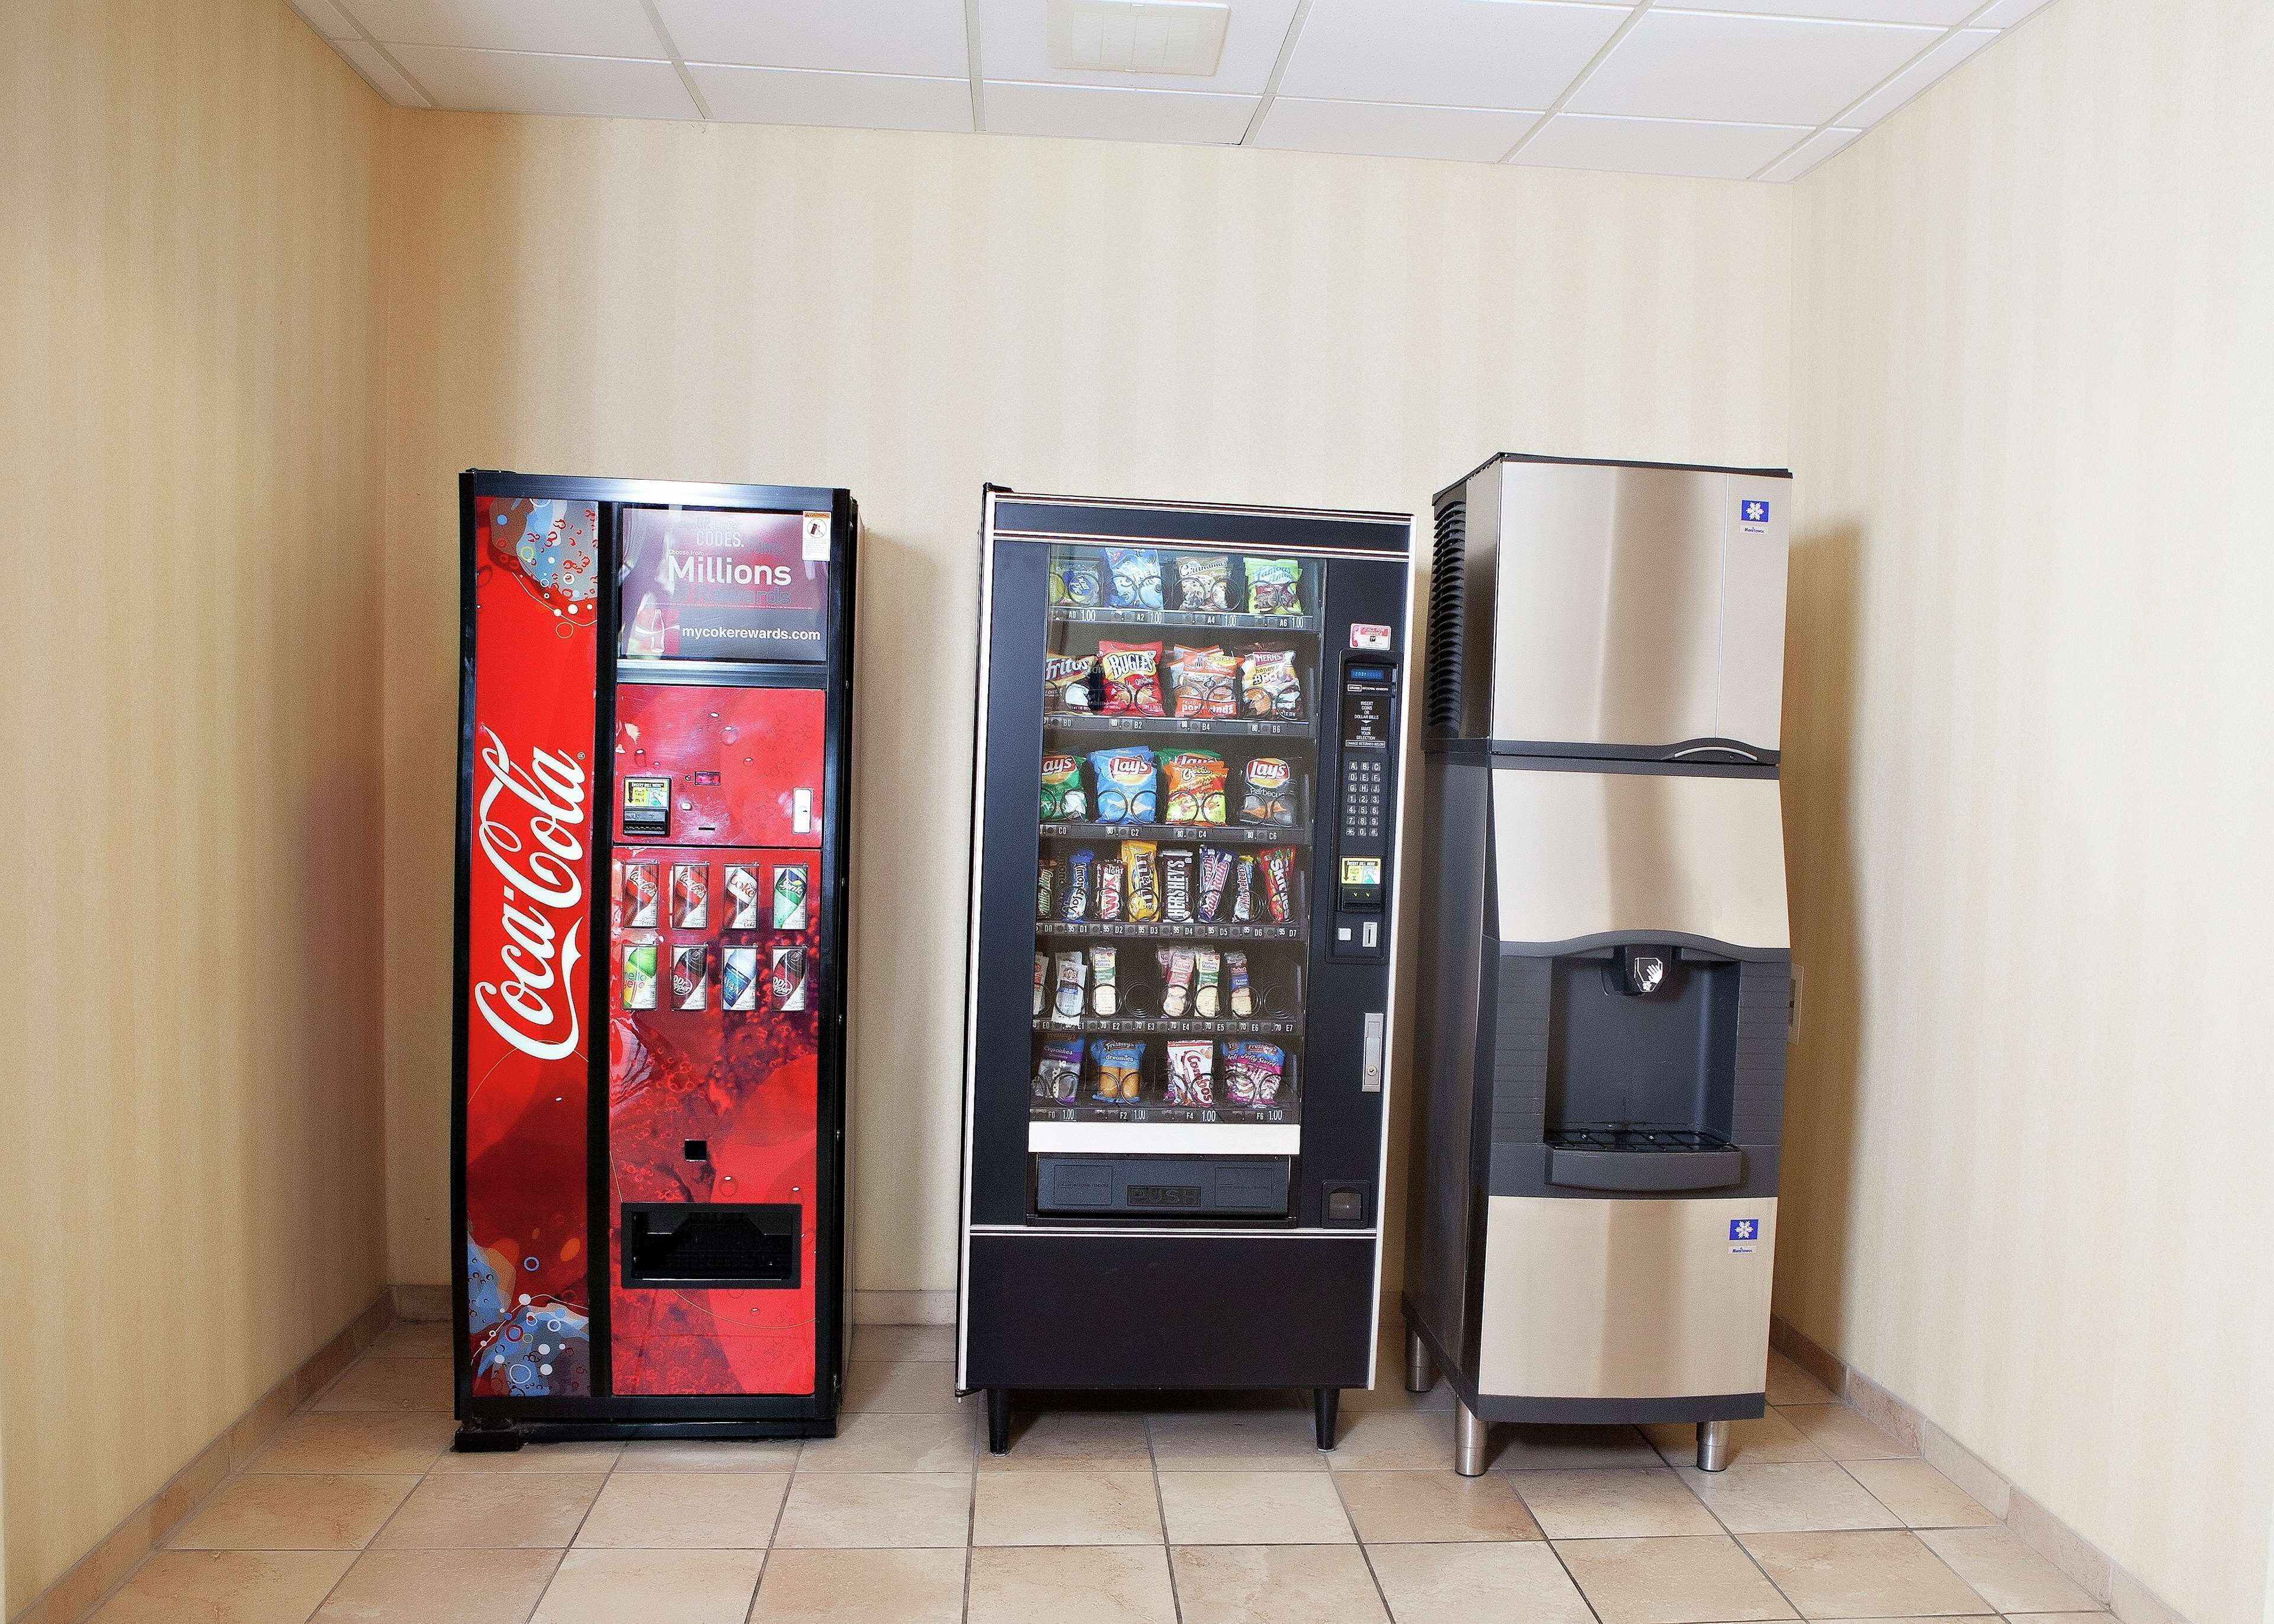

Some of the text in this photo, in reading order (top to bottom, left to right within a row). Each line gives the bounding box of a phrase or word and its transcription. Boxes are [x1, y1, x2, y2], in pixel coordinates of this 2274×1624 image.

[696, 530, 744, 548] CODES.
[668, 557, 791, 586] Millions
[1069, 609, 1096, 621] A0 1.00
[1150, 612, 1162, 624] 1.00
[1225, 615, 1237, 627] 1.00
[1291, 617, 1304, 628] 1.00
[682, 626, 820, 641] mycokerewards.com
[1108, 654, 1153, 679] BUGLES
[1134, 721, 1143, 729] B2
[1113, 758, 1149, 775] Lay's
[1250, 788, 1285, 798] Barbecue
[475, 724, 585, 1060] Coca-Cola
[1115, 926, 1123, 934] D2
[1185, 927, 1193, 935] D4
[1255, 928, 1262, 936] D6
[1044, 1045, 1073, 1055] Cupcakes
[1240, 1054, 1258, 1063] Jelly
[1257, 1057, 1278, 1067] Swirl
[1187, 1055, 1213, 1102] Combos
[1063, 1109, 1075, 1120] 1.00
[1186, 1111, 1216, 1122] F4 1.00
[1268, 1110, 1282, 1121] 1.00
[1130, 1187, 1198, 1204] PUSH
